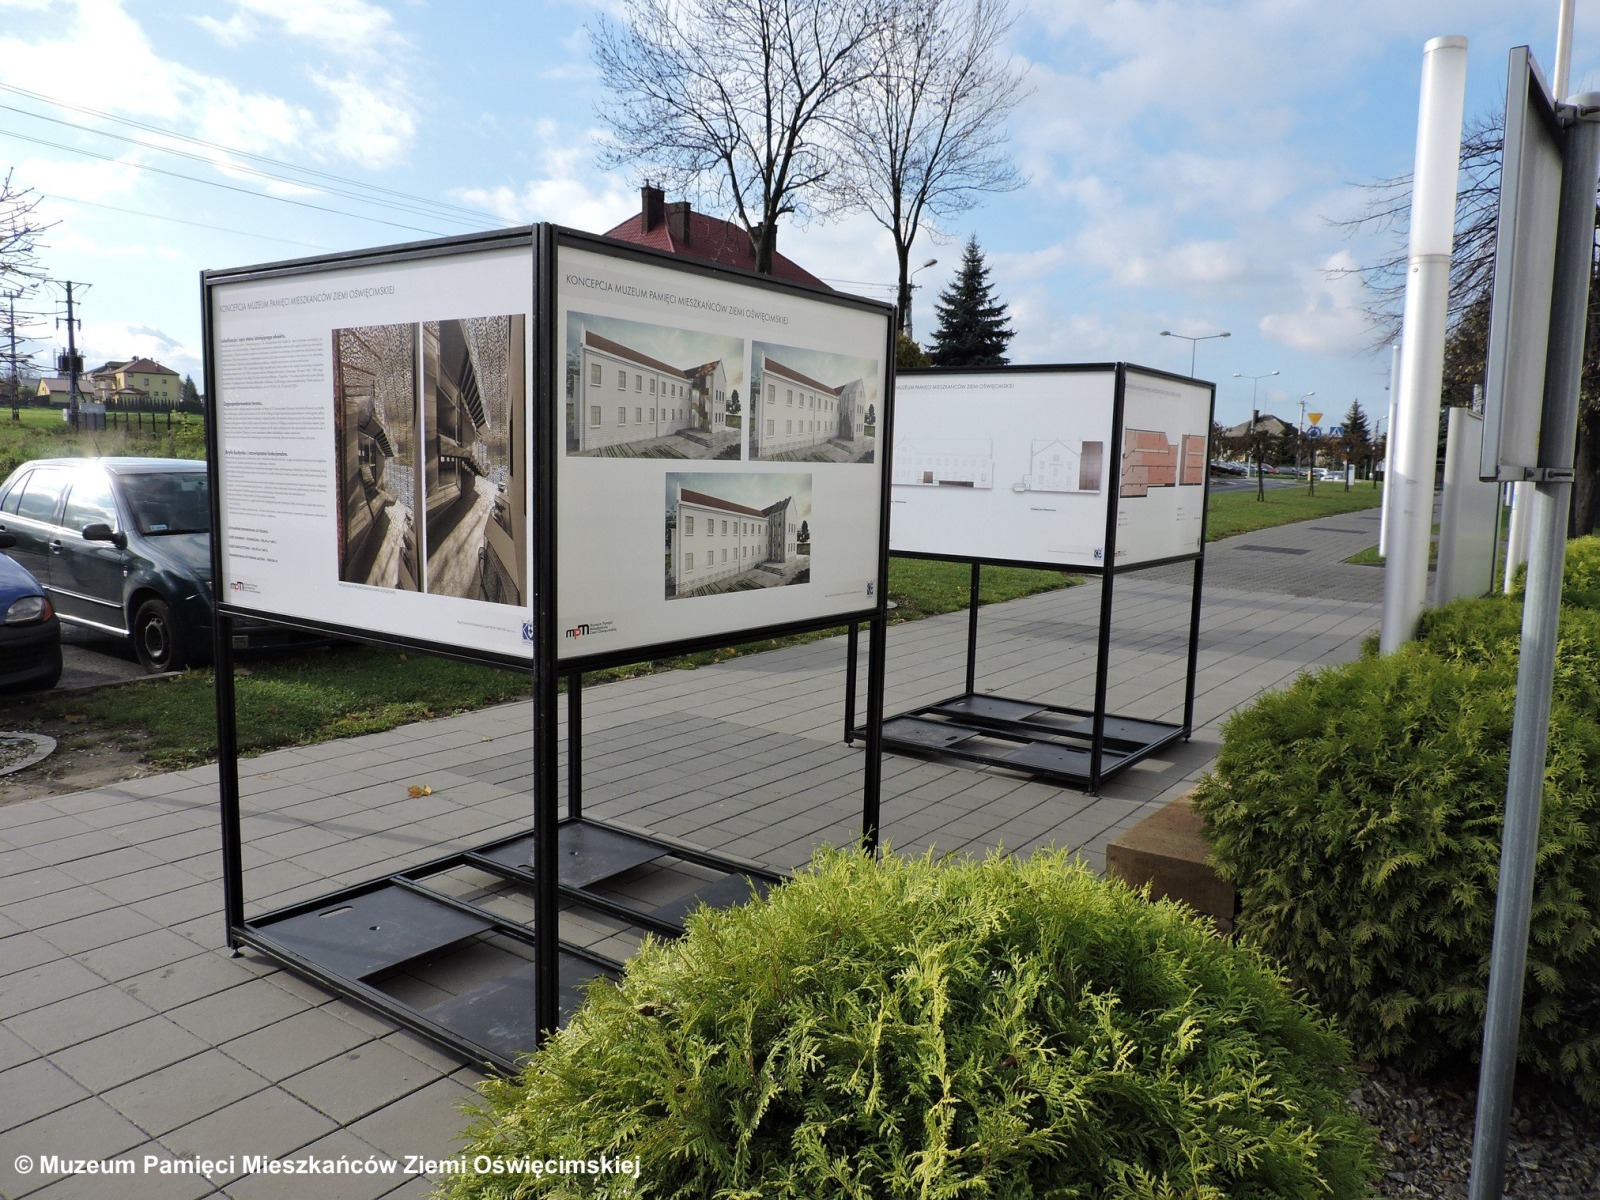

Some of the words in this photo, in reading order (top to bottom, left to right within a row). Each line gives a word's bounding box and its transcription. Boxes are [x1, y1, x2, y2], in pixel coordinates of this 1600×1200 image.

[333, 291, 349, 301] ZIEMI
[349, 286, 395, 299] OŚWIĘCIMSKIEJ
[566, 274, 613, 292] KONCEPCJA
[614, 284, 649, 299] MUZEUM
[649, 291, 677, 305] PAMIĘCI
[677, 296, 728, 312] MIESZKAŃCÓW
[728, 306, 745, 317] ZIEMI
[745, 309, 789, 325] OŚWIĘCIMSKIEJ
